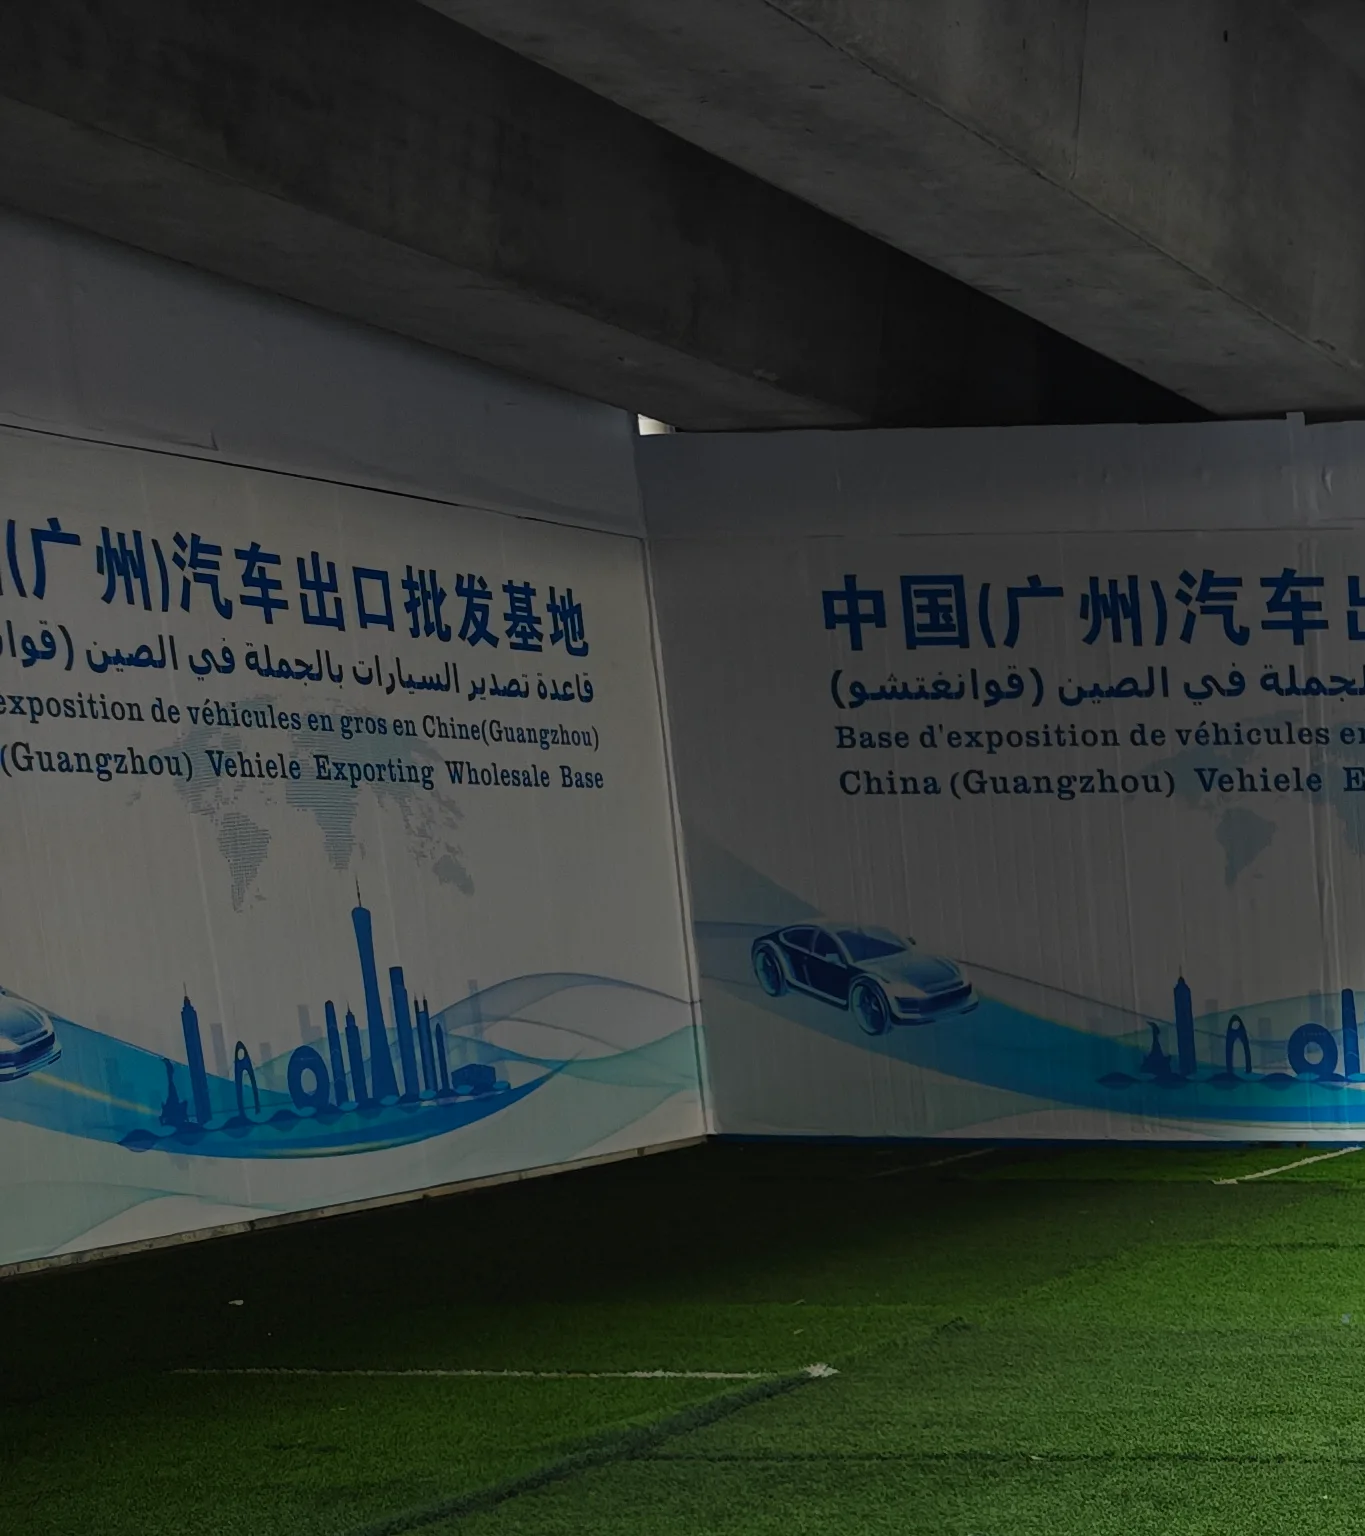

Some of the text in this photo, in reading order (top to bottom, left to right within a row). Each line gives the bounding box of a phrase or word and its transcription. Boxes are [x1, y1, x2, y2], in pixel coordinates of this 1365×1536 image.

[0, 518, 589, 657] (广州)汽车出口批发基地
[86, 633, 178, 673] الصين
[188, 637, 236, 681] في
[1058, 665, 1169, 707] الصين
[1183, 667, 1246, 706] في
[151, 697, 181, 723] de
[187, 699, 302, 731] véhicules
[307, 713, 335, 732] en
[340, 715, 388, 740] gros
[392, 717, 418, 737] en
[422, 715, 601, 752] Chine(Guangzhou)
[835, 726, 910, 749] Base
[919, 724, 1120, 755] d'exposition
[1130, 723, 1167, 748] de
[1175, 720, 1330, 746] véhicules
[0, 742, 605, 791] (Guangzhou) Vehiele Exporting Wholesale Base
[839, 768, 942, 796] China
[949, 768, 1177, 800] (Guangzhou)
[1193, 767, 1323, 793] Vehiele
